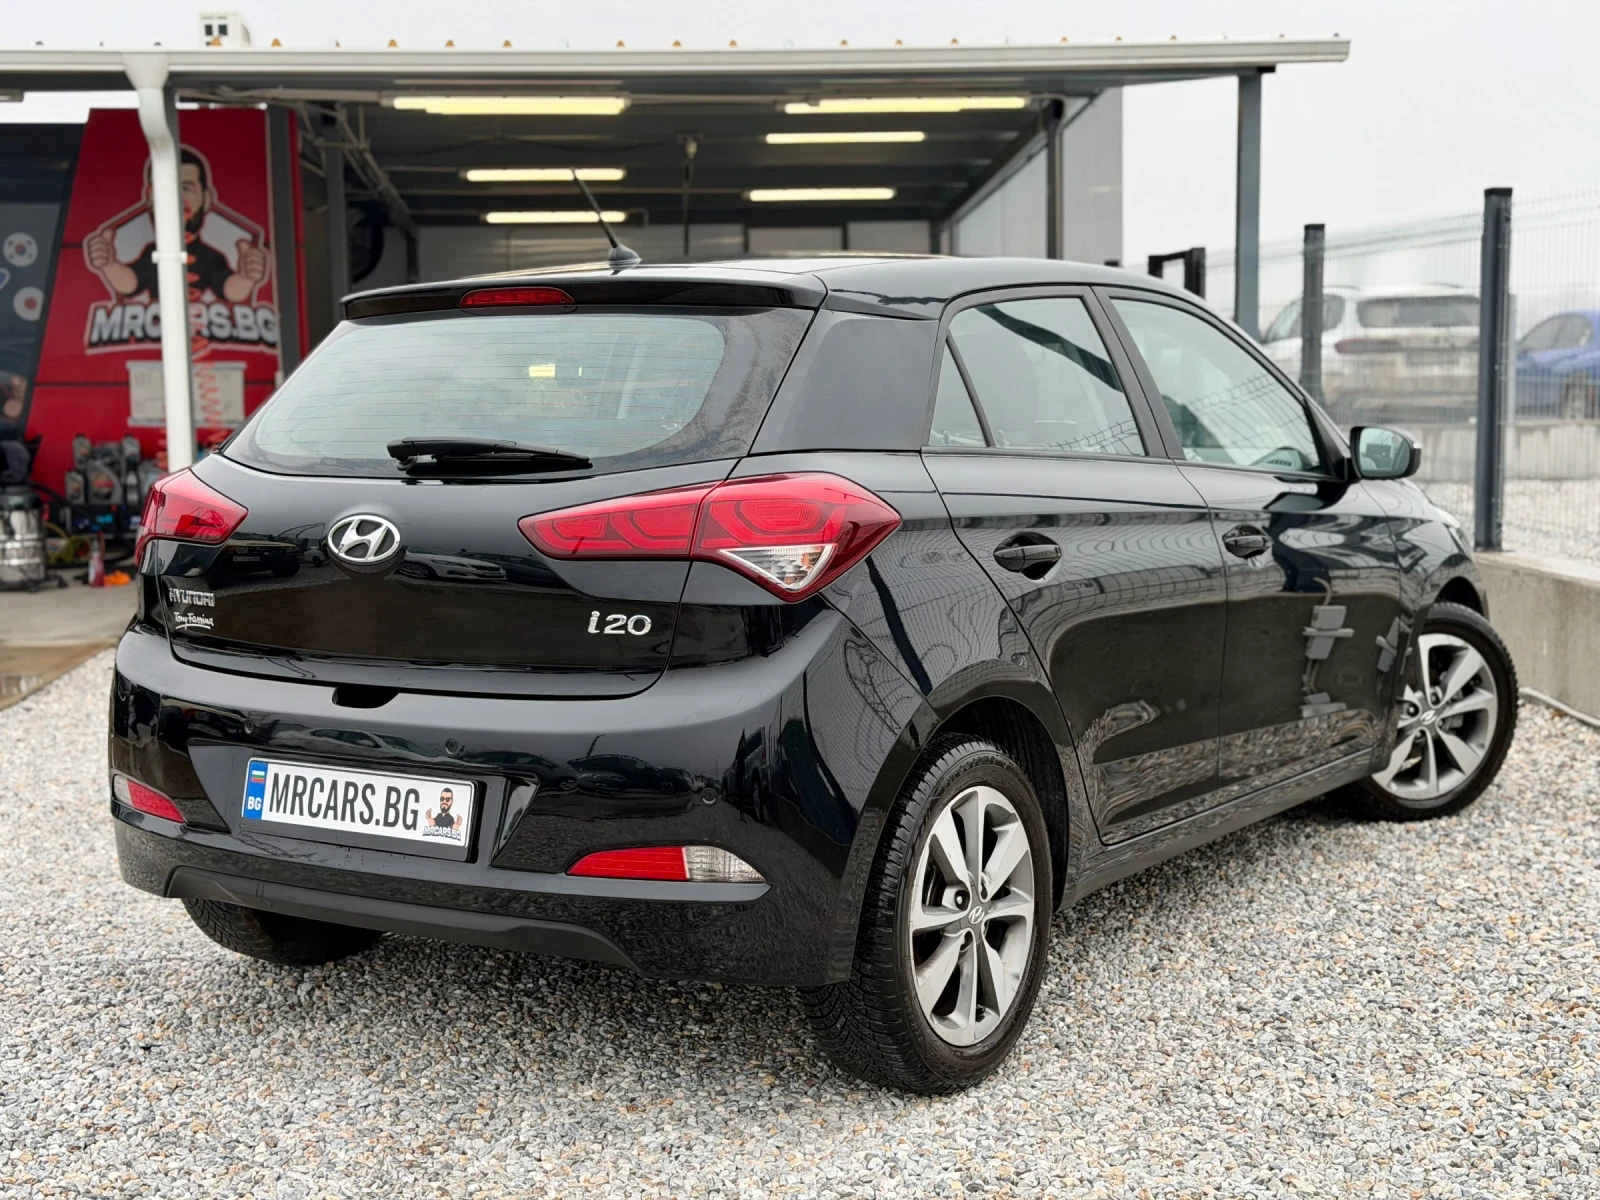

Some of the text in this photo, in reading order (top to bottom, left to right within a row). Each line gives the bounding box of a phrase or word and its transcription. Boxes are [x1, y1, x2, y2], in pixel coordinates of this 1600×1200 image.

[90, 304, 279, 345] MRCRS.BG
[168, 588, 215, 607] HYUNDAI
[587, 610, 652, 636] i20
[247, 796, 262, 811] BG
[268, 772, 421, 831] MRCARS.BG
